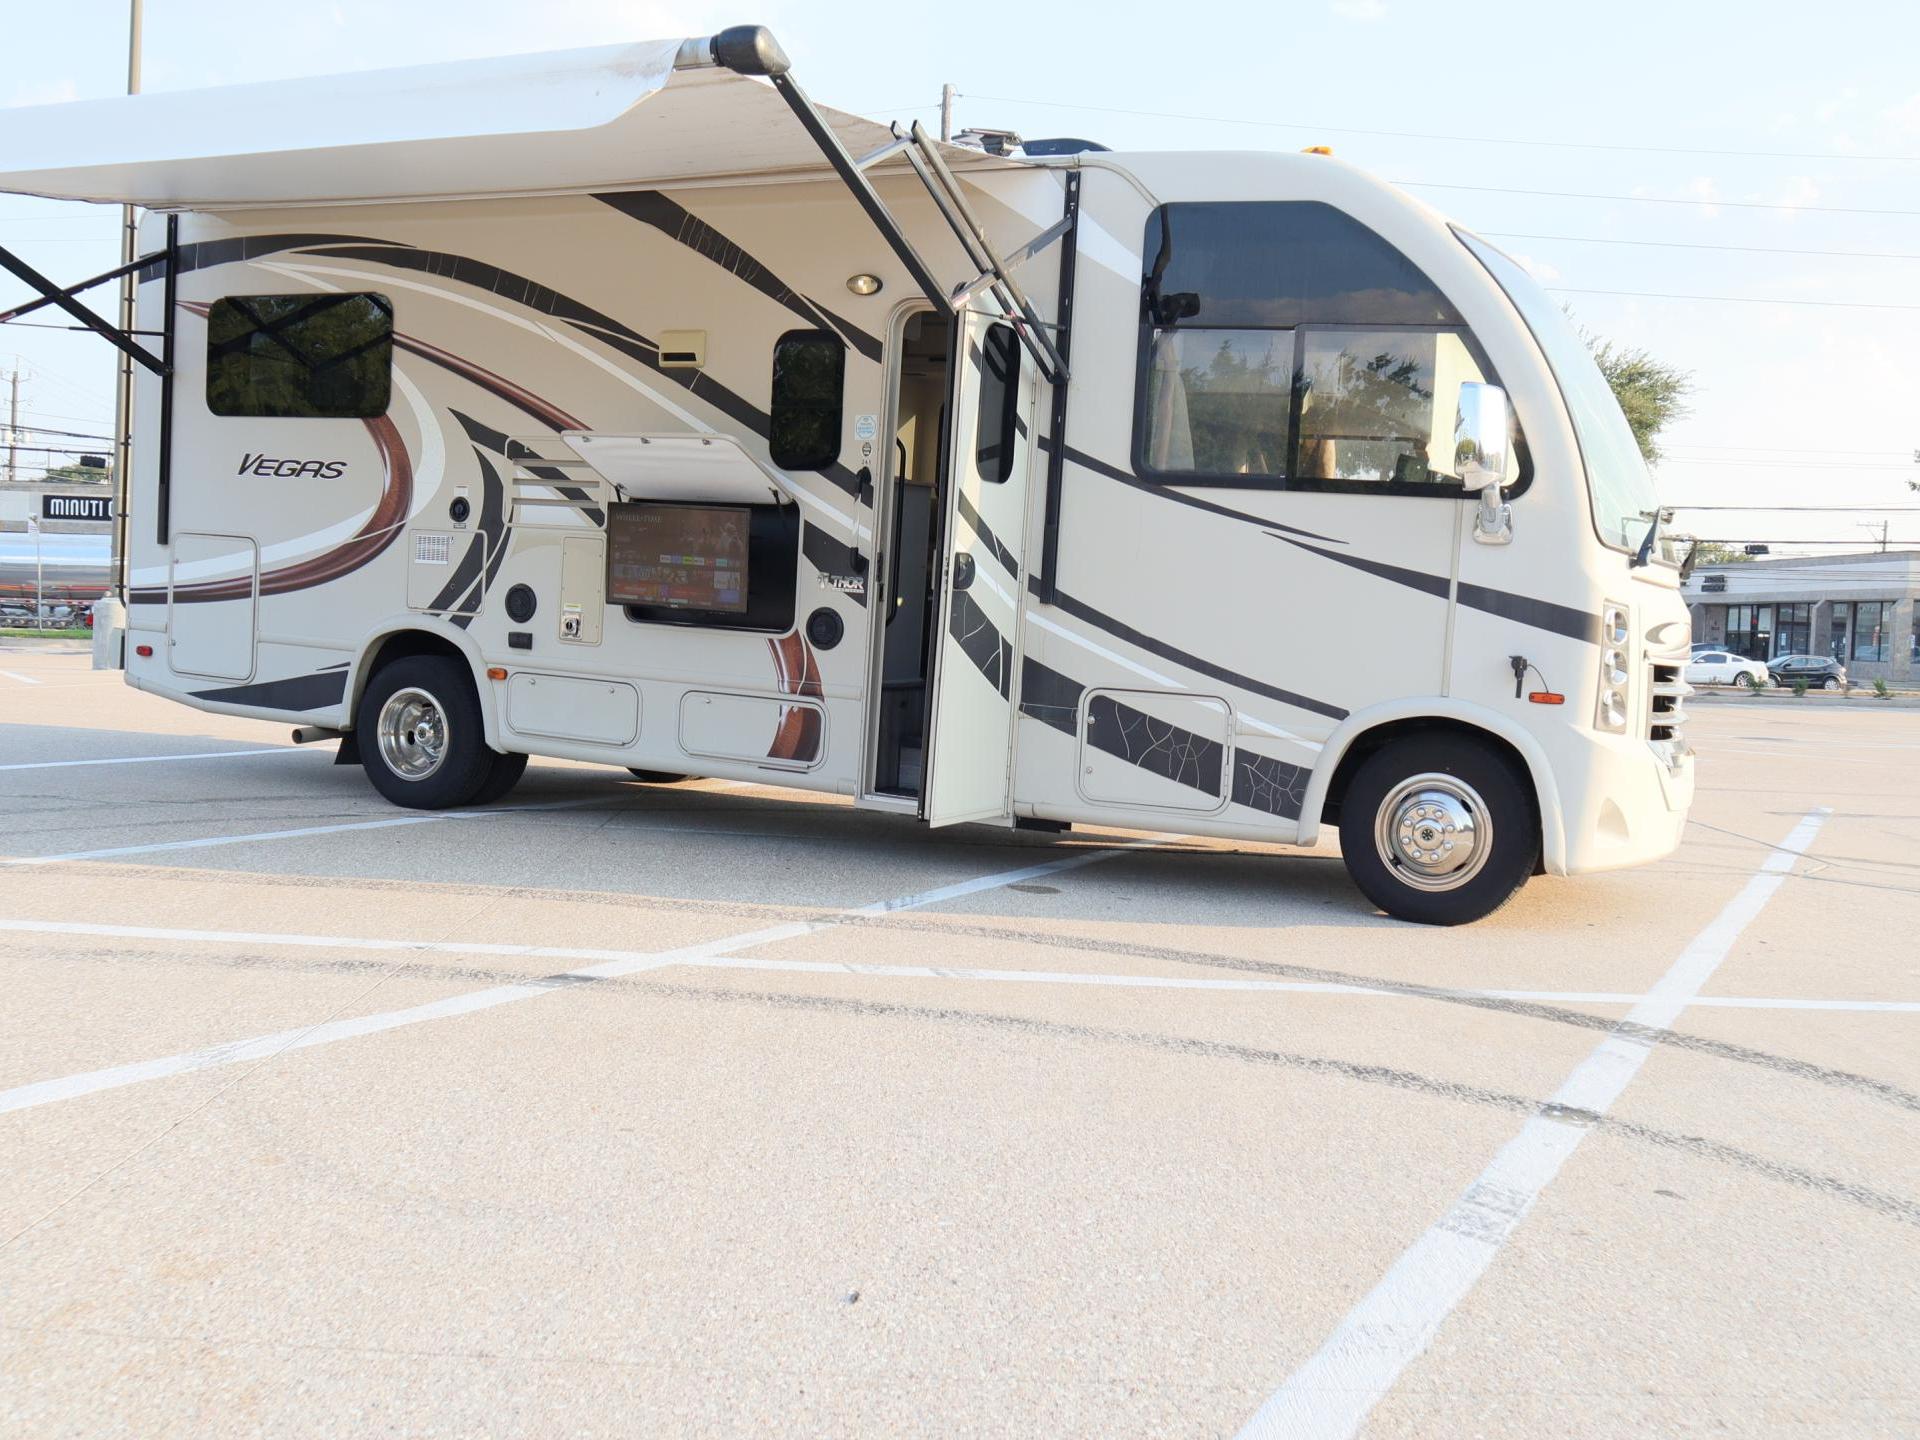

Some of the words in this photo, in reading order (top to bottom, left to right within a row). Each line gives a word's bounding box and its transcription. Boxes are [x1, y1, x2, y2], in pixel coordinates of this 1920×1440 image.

[238, 453, 347, 479] VEGAS
[50, 498, 103, 517] MINUTI
[830, 575, 864, 589] THOR
